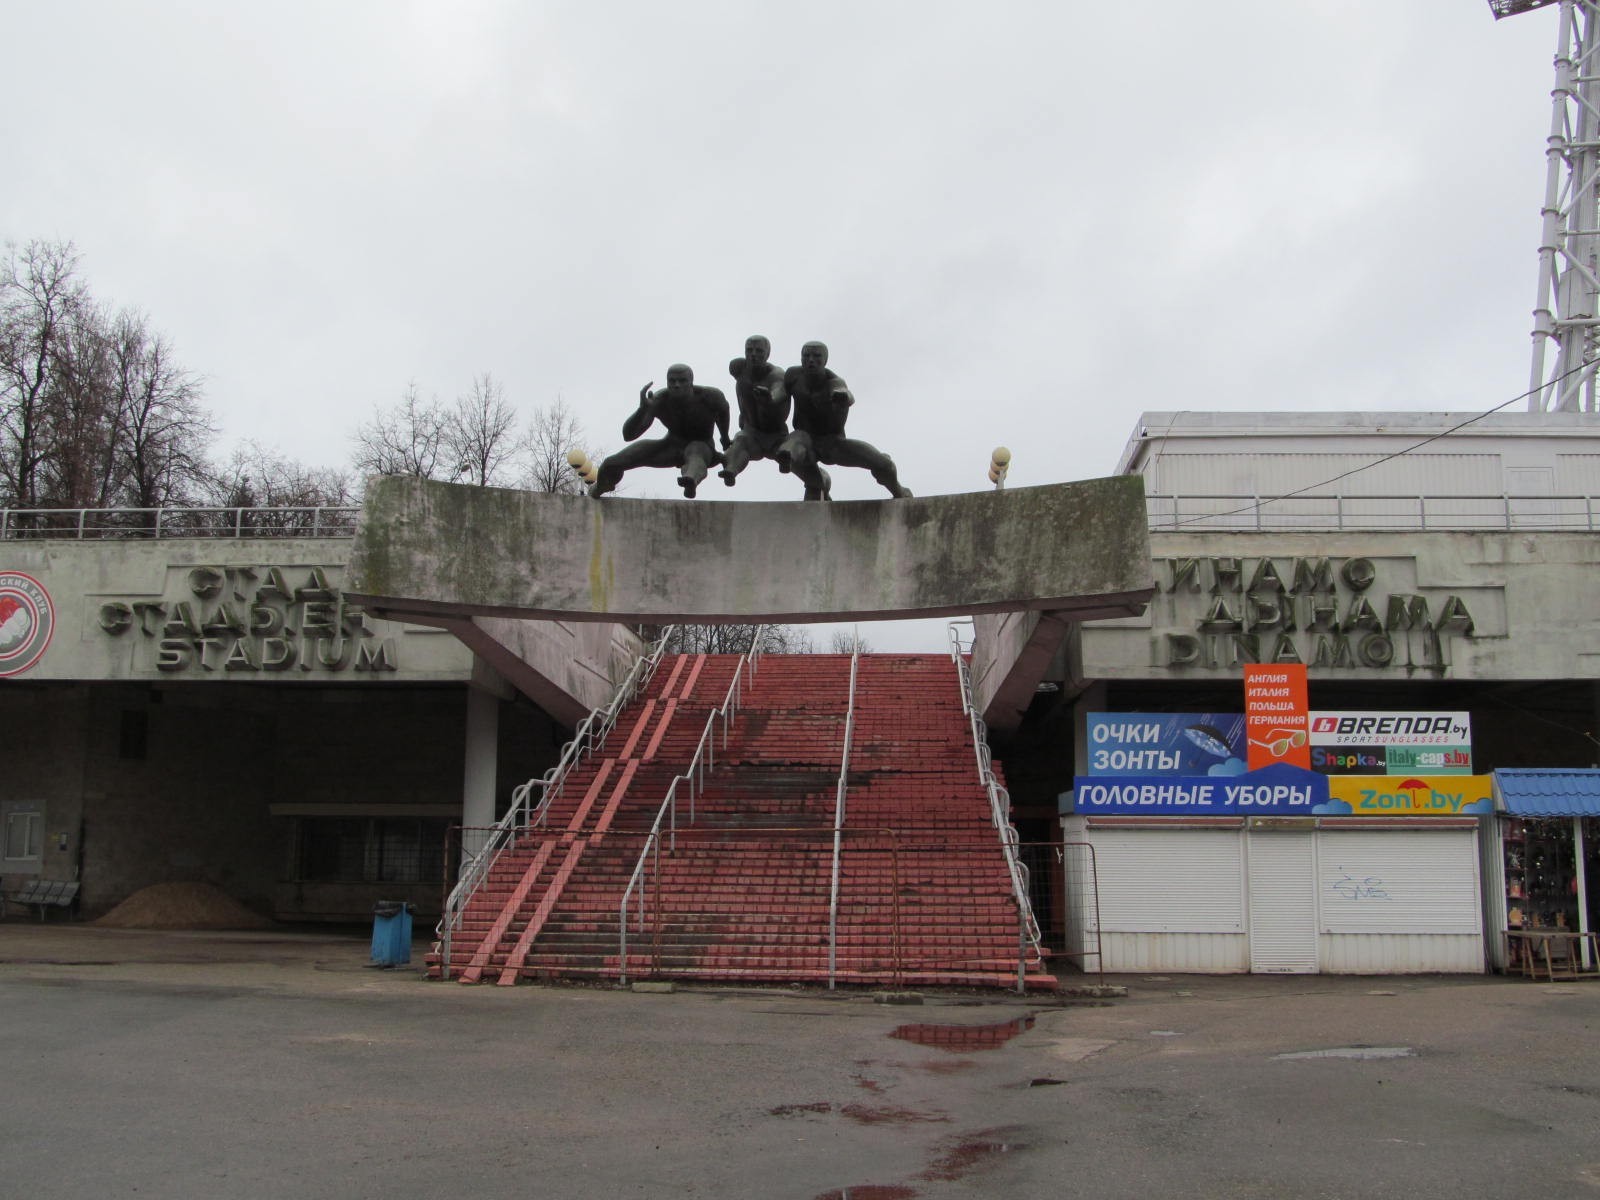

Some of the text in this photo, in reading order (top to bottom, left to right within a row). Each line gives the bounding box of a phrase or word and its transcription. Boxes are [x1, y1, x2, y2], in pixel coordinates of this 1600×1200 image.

[1154, 556, 1376, 593] ИНАМО
[156, 637, 398, 672] STADIUM
[1163, 631, 1394, 669] DINAMO
[1248, 674, 1288, 683] АНГЛИЯ
[1249, 688, 1290, 697] ИТАЛИЯ
[1249, 702, 1295, 711] ПОЛЬША
[1249, 716, 1305, 725] ГЕРМАНИЯ
[1092, 724, 1161, 743] ОЧКИ
[1093, 750, 1181, 770] ЗОНТЫ
[1078, 785, 1311, 806] ГОЛОВНЫЕ УБОРЫ
